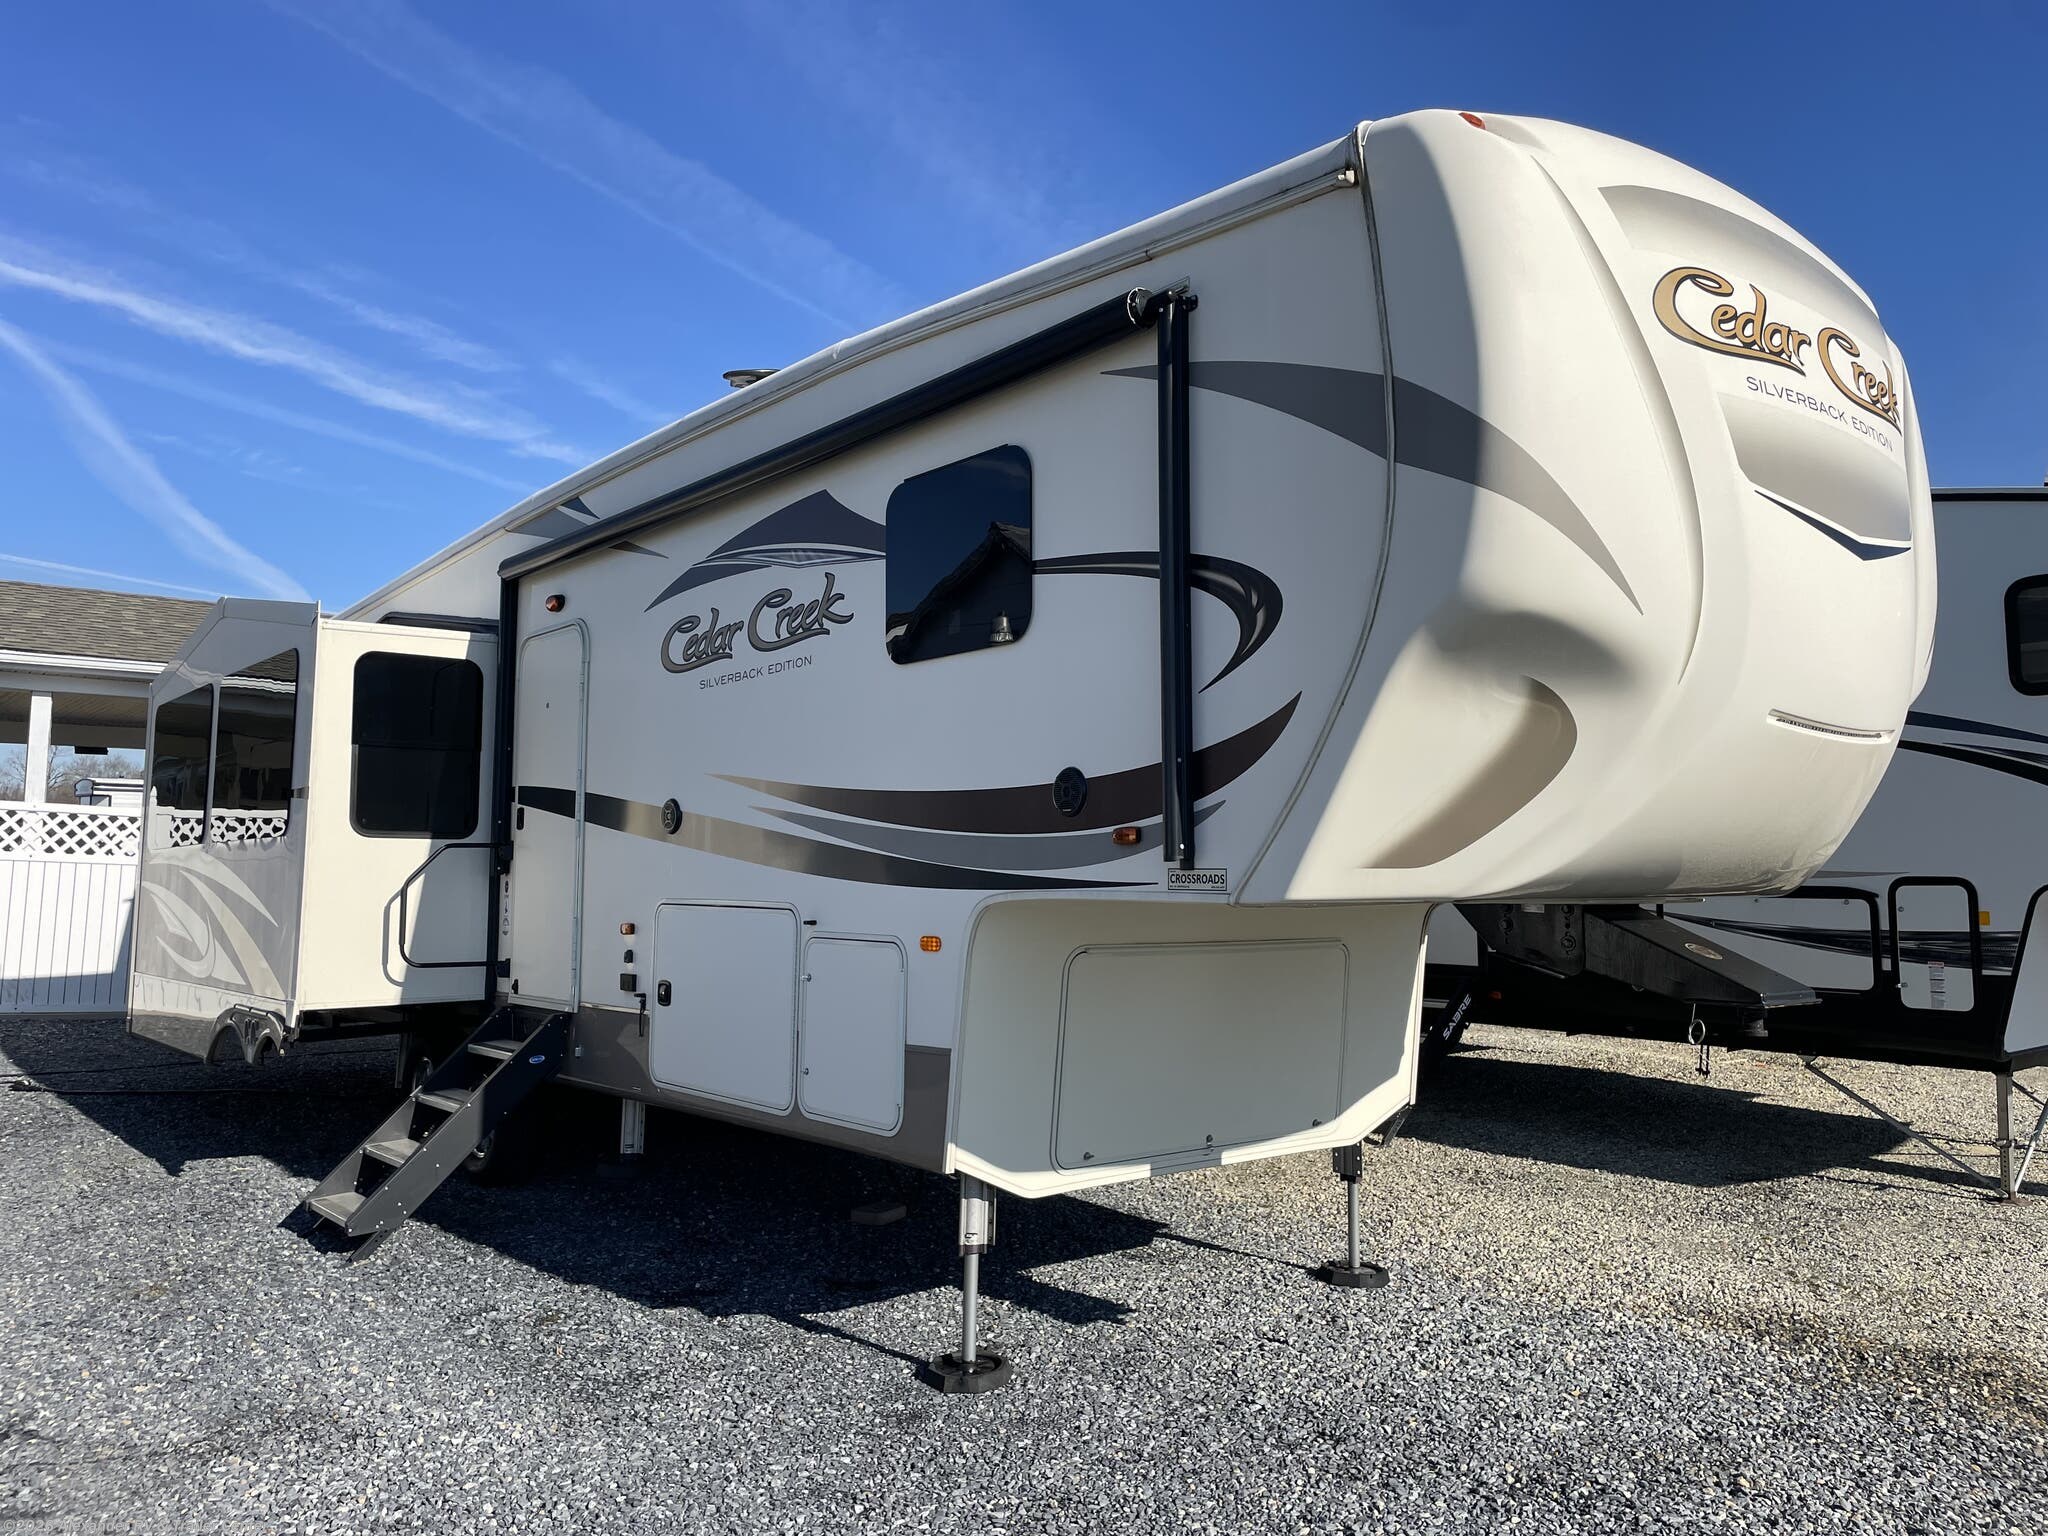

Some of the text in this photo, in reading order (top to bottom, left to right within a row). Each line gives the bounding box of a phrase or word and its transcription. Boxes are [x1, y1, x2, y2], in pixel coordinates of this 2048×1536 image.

[1652, 266, 1902, 436] Cedar Creek
[1746, 376, 1894, 452] SILVERBACK EDITION
[660, 571, 854, 673] Cedar Creek
[699, 655, 812, 690] SILVERBACK EDITION
[1169, 873, 1225, 885] CROSSROADS
[1442, 993, 1472, 1041] SABRE
